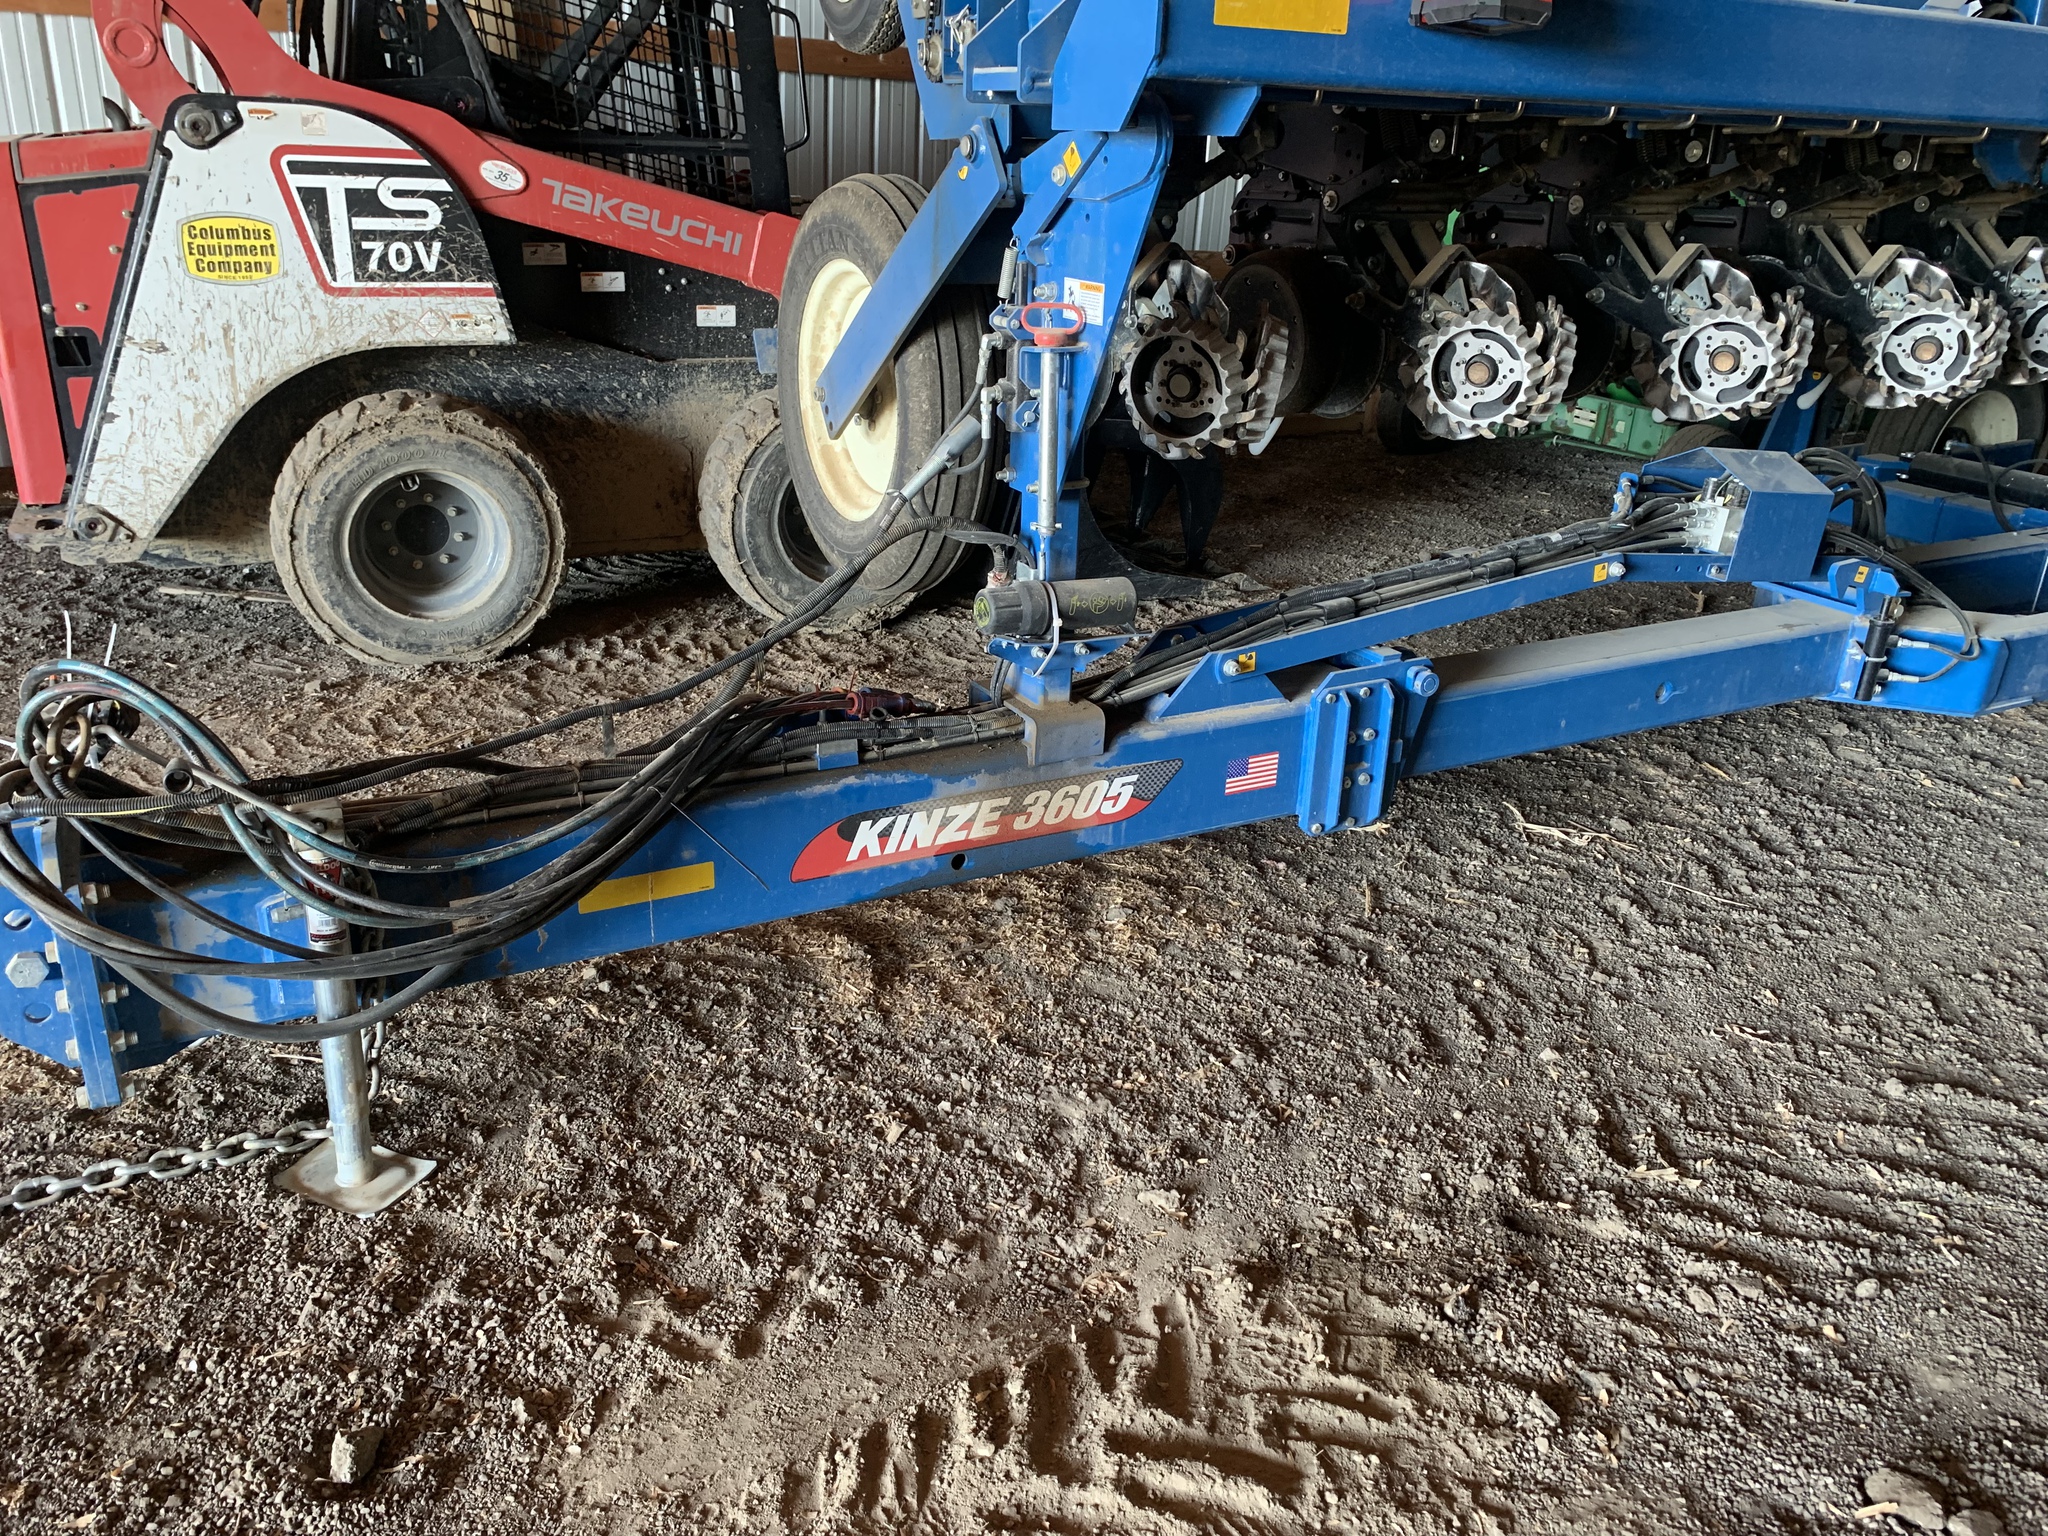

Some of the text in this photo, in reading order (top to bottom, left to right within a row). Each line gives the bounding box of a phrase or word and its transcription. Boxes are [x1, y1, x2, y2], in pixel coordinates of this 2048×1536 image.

[494, 170, 510, 182] 35
[187, 224, 272, 241] Columbus
[286, 173, 454, 284] TS
[187, 241, 276, 258] Equipment
[361, 241, 442, 273] 70V
[195, 258, 272, 274] Company
[846, 774, 1139, 862] KINZE 3605
